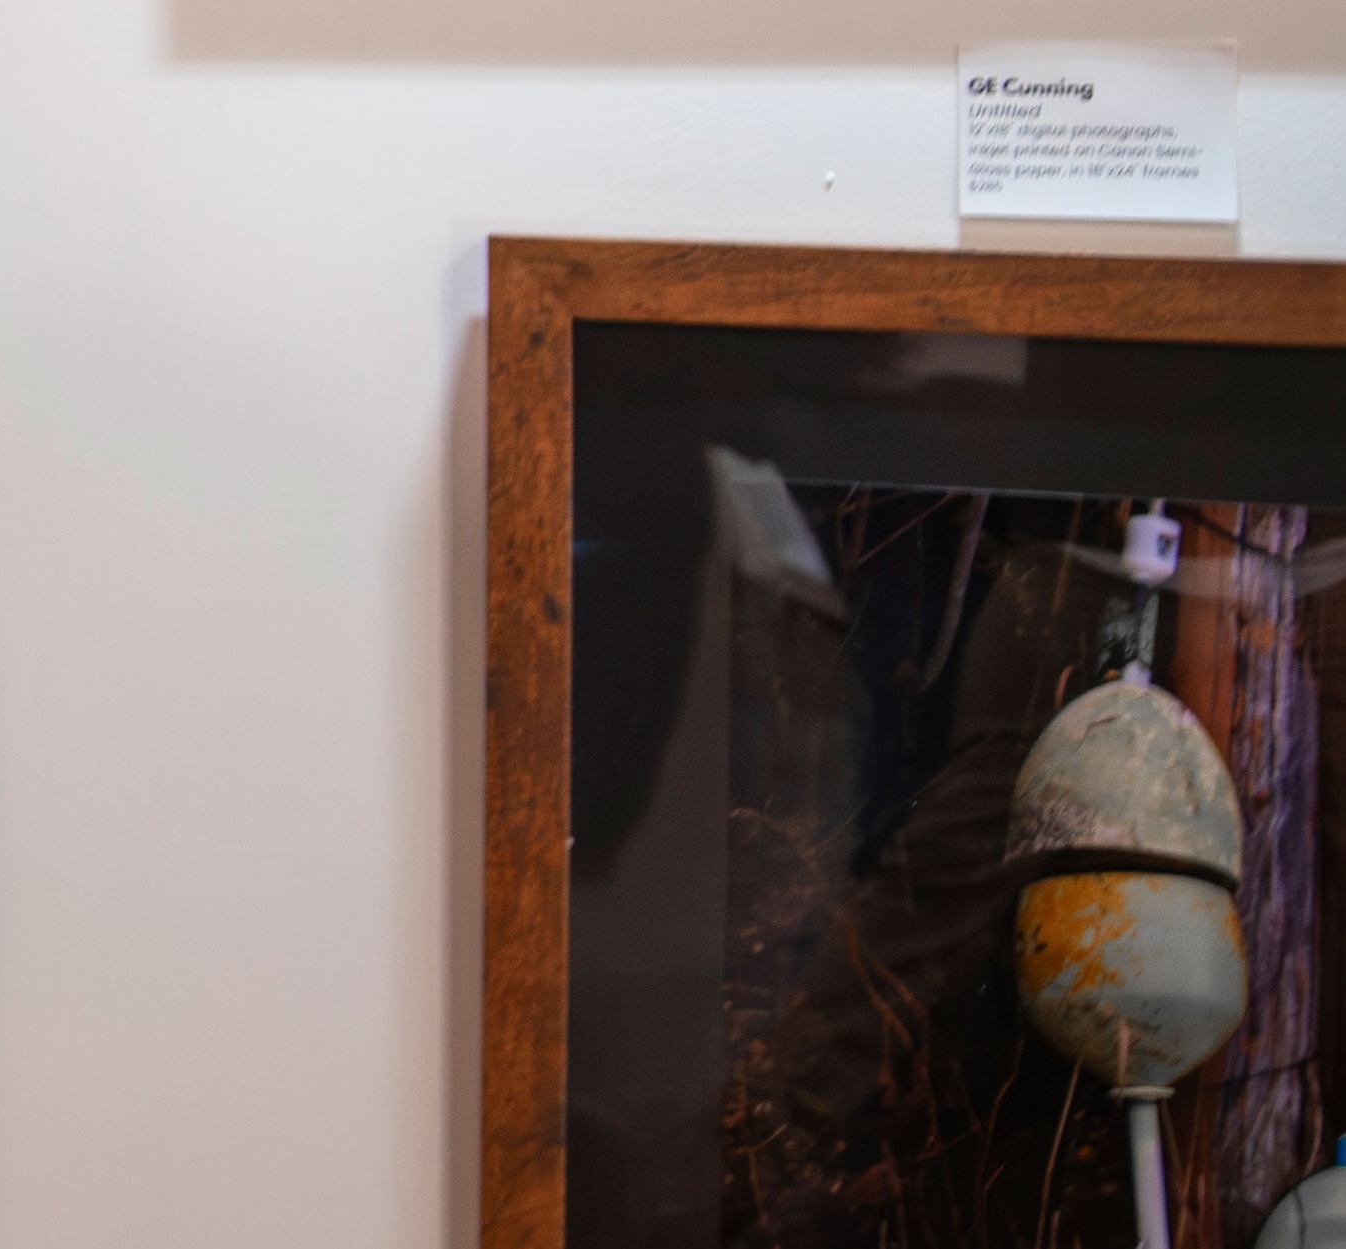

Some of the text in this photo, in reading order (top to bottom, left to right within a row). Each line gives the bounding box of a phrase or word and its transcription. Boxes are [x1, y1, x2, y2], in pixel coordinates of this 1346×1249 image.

[968, 76, 1095, 101] GE Cunning
[968, 103, 1043, 119] Untitled
